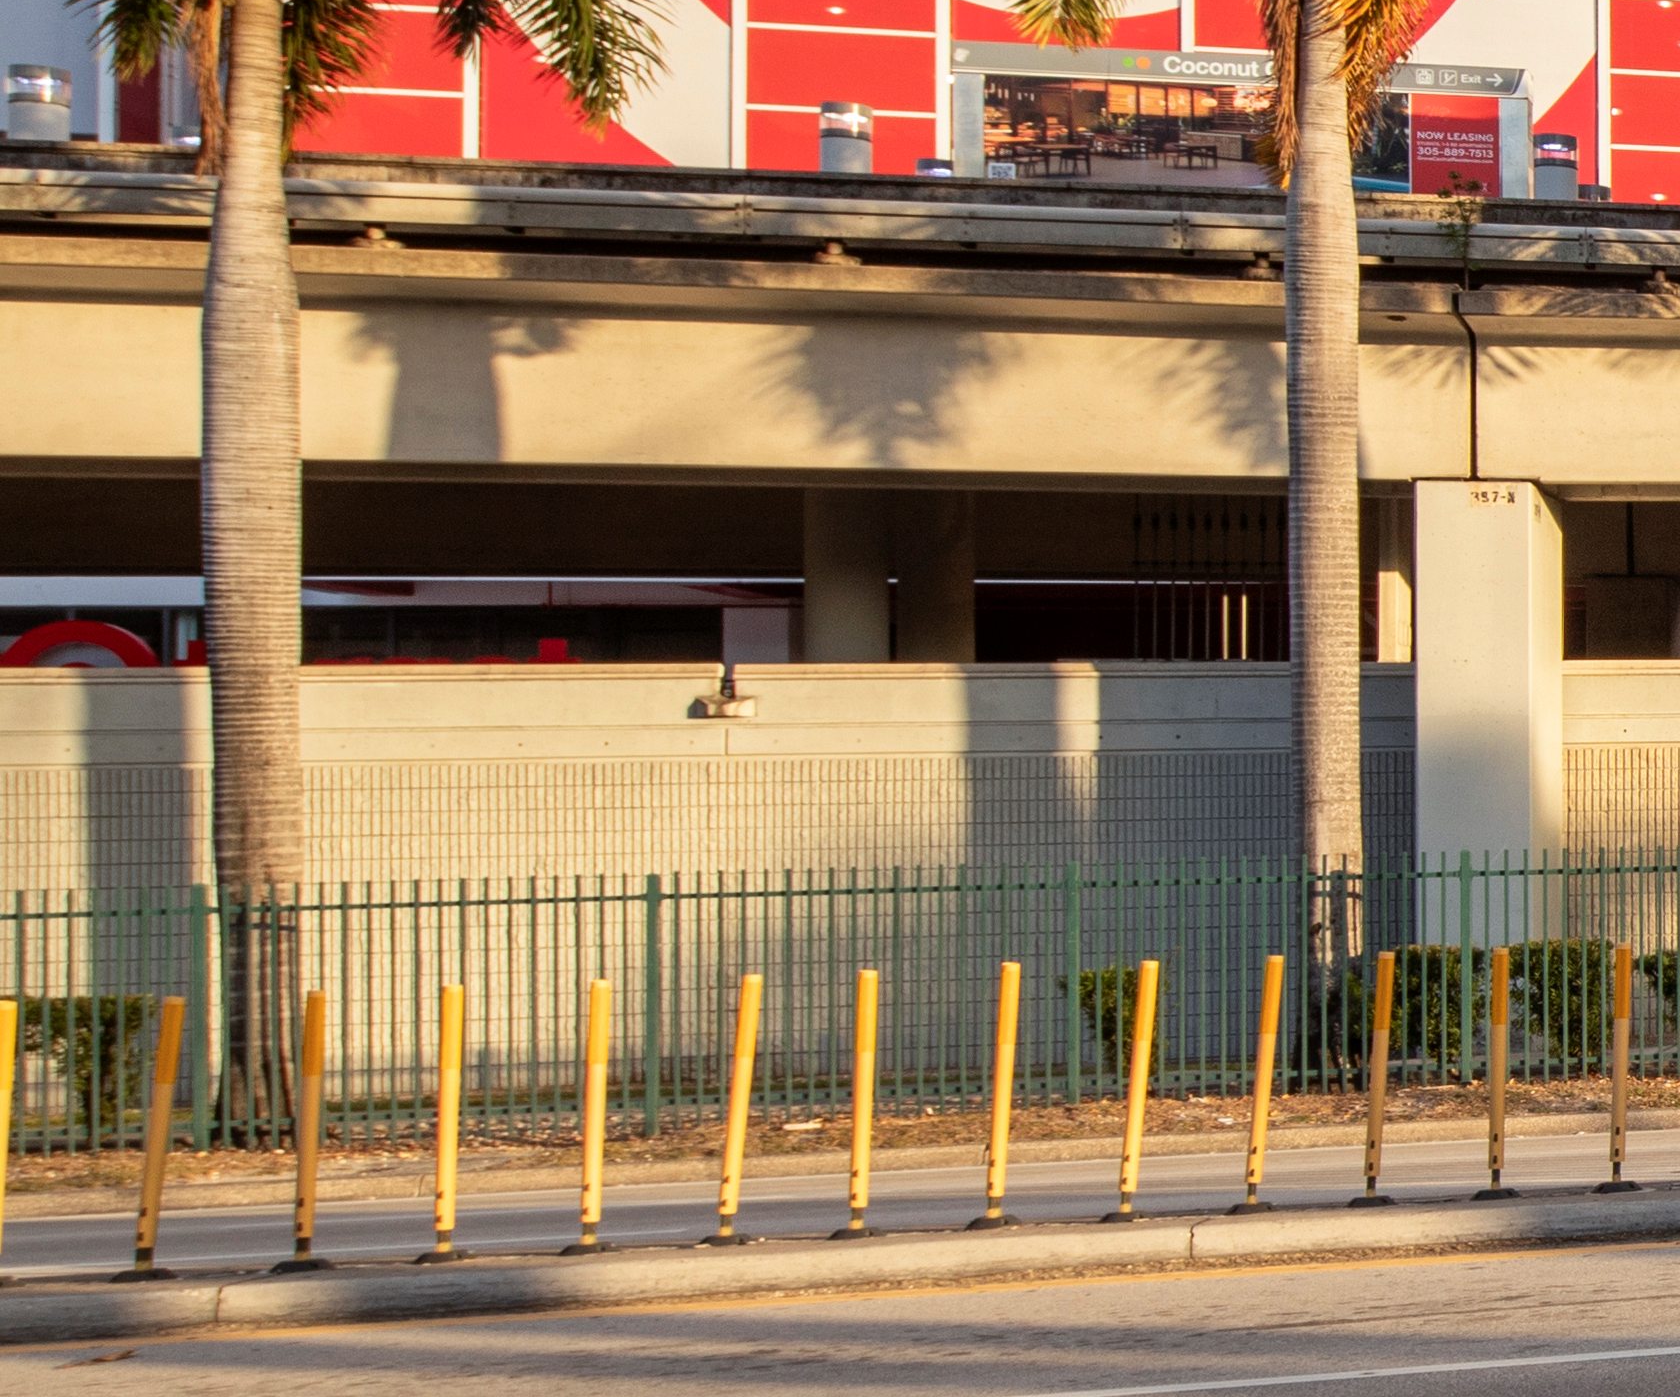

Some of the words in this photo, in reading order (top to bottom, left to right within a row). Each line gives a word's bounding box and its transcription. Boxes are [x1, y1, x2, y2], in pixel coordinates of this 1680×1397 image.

[1163, 56, 1260, 77] Coconut
[1460, 73, 1481, 84] Exit
[1416, 131, 1445, 140] NOW
[1446, 132, 1494, 142] LEASING
[1416, 146, 1494, 158] 305-889-7513
